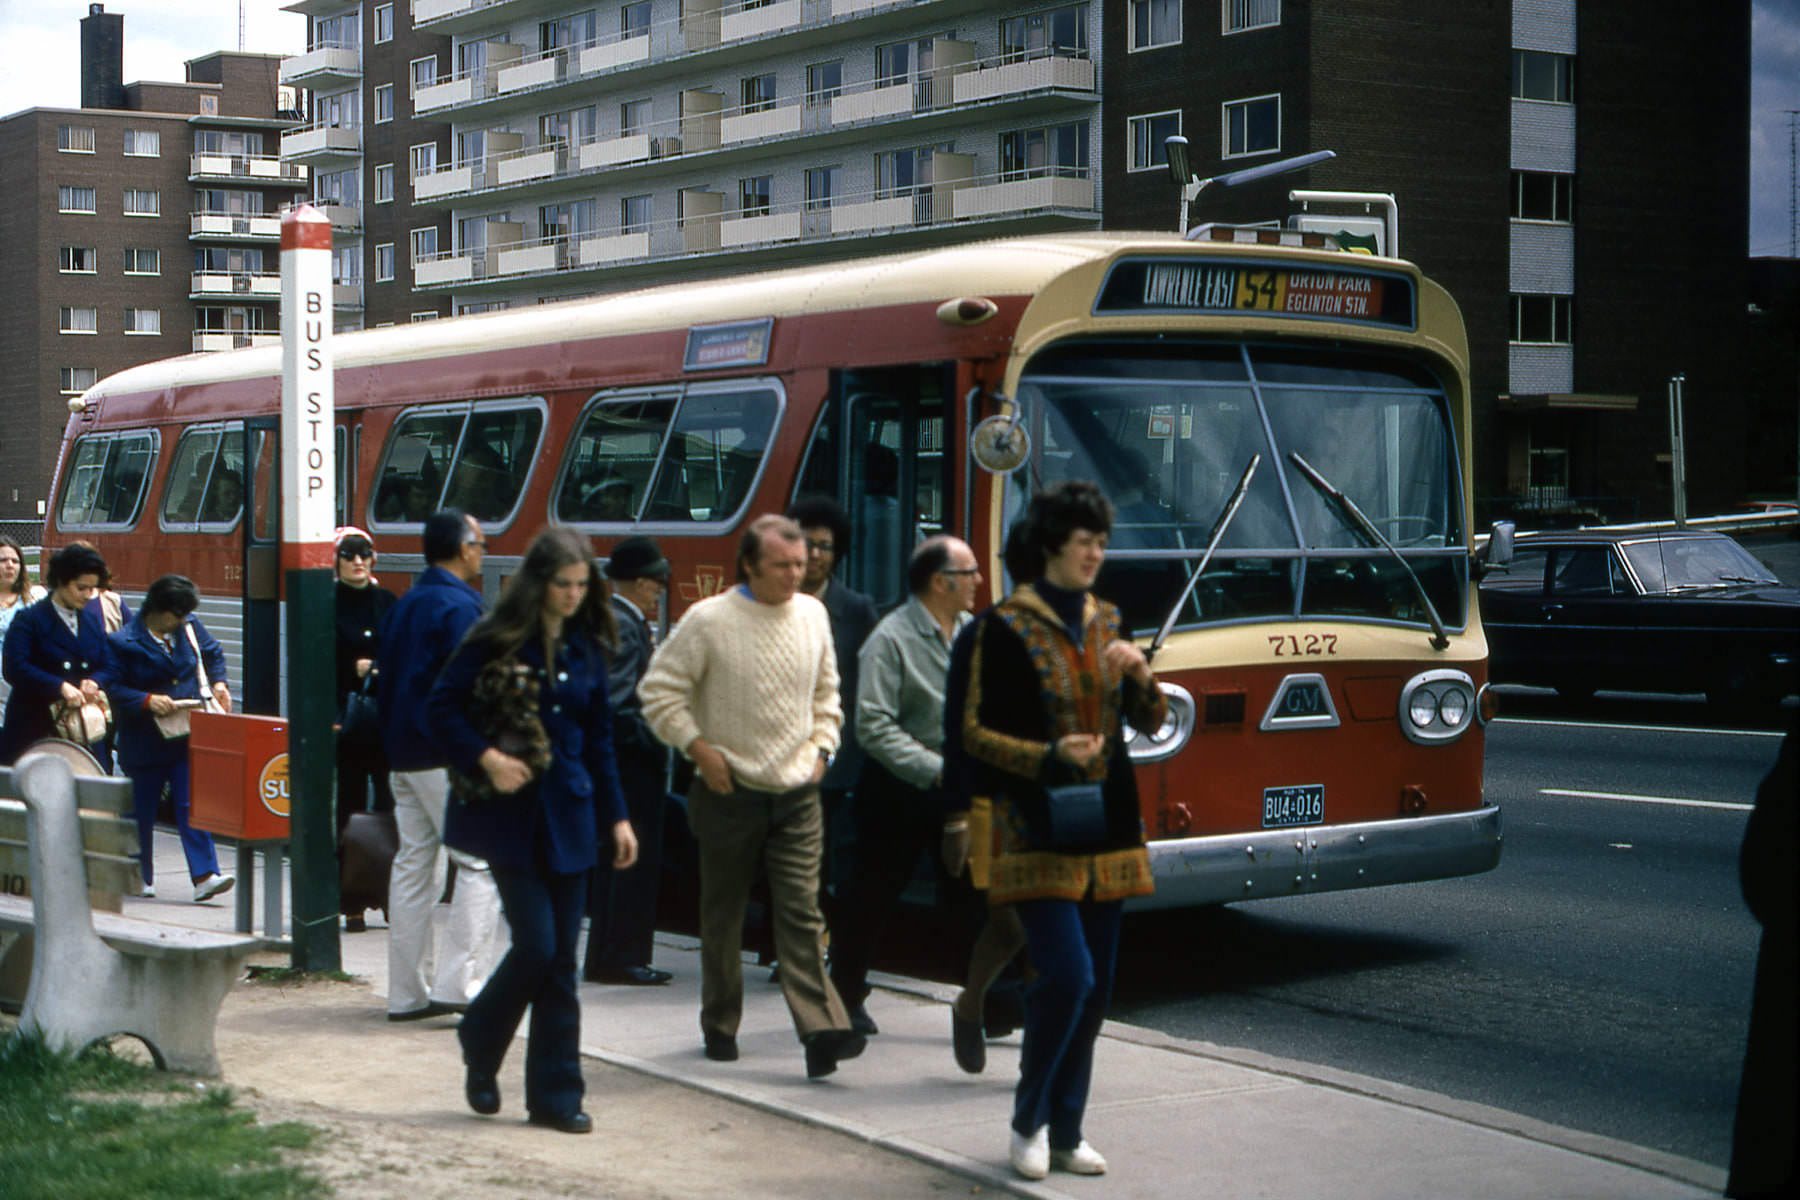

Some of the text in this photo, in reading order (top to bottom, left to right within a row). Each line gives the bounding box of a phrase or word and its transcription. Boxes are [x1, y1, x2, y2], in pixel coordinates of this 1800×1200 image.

[1242, 270, 1278, 309] 54
[1287, 293, 1342, 313] EGLINTON
[306, 292, 323, 498] BUS STOP
[1268, 634, 1338, 656] 7127
[1286, 688, 1320, 712] GM
